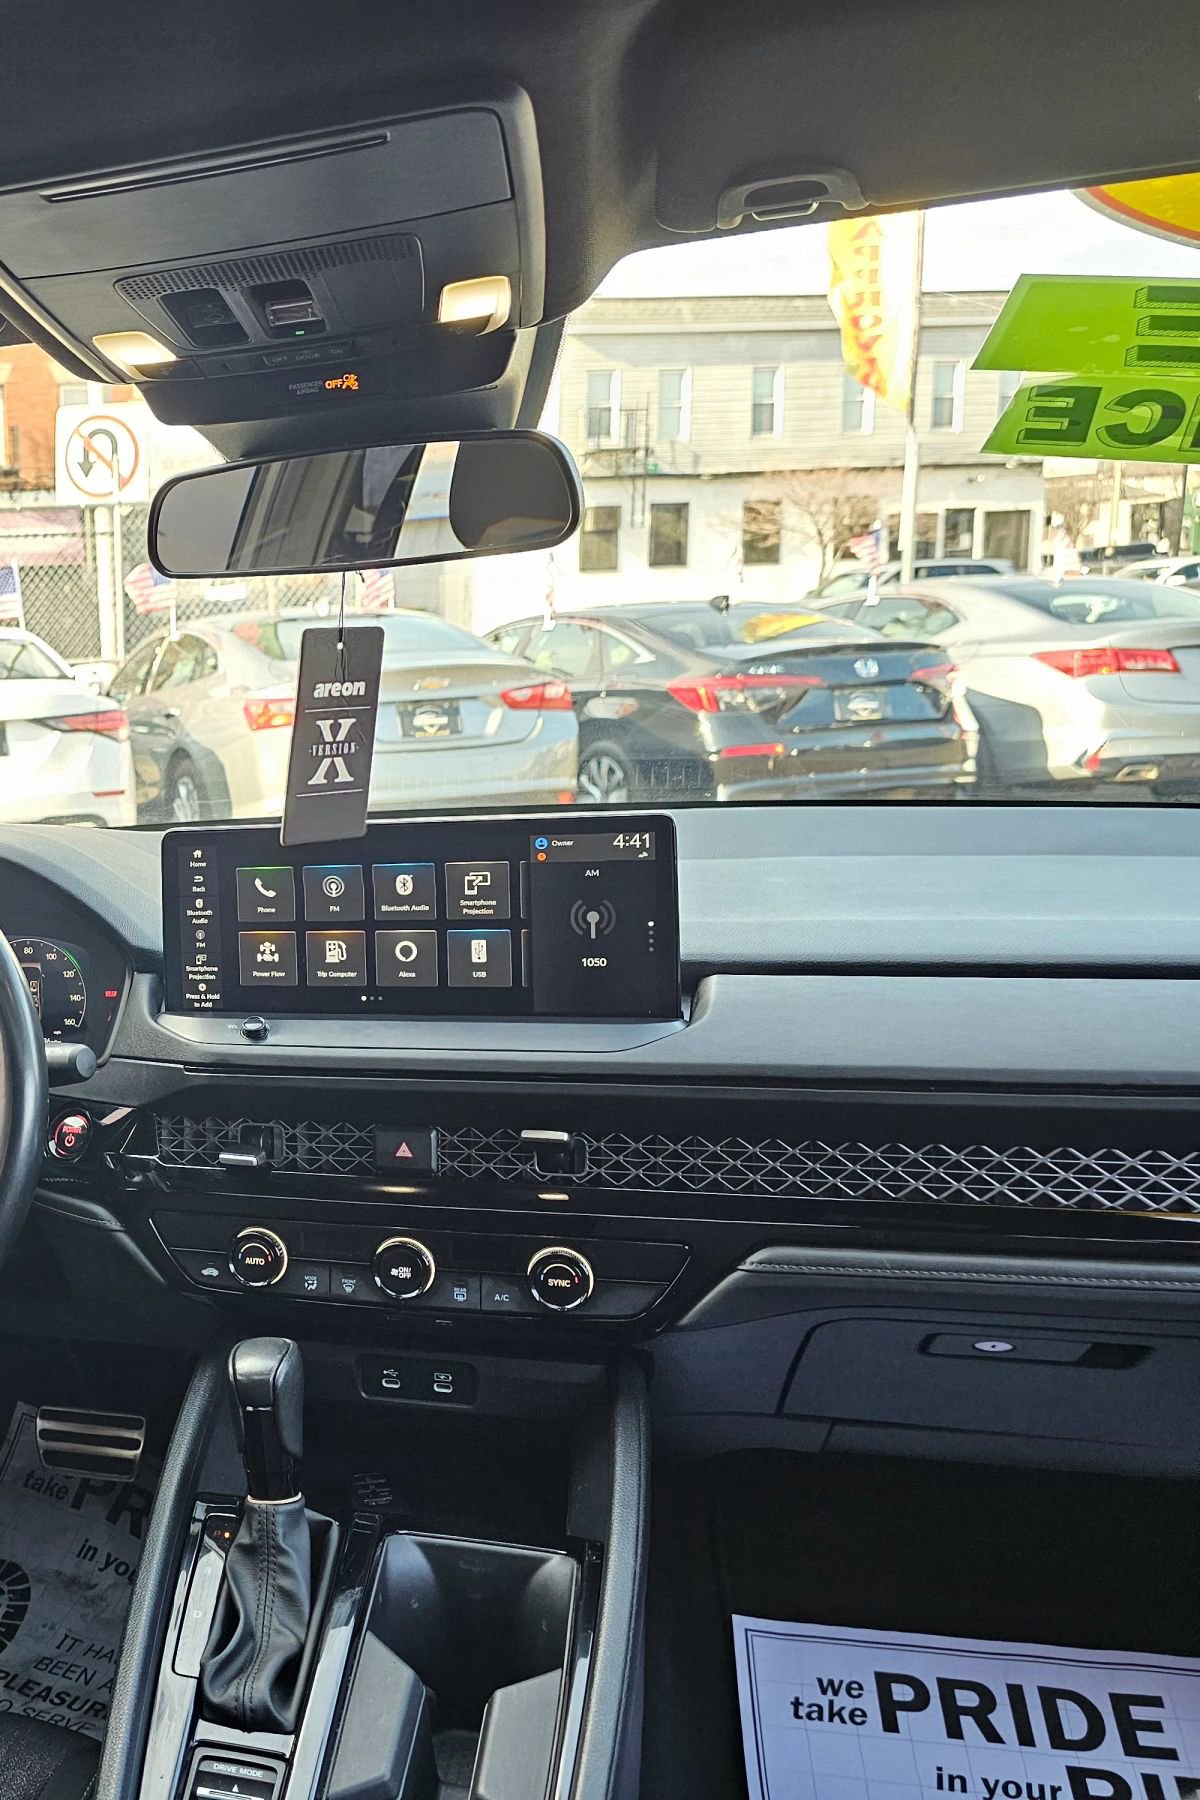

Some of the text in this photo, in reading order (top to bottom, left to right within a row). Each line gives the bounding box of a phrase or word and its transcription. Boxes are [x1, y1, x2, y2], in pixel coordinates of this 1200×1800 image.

[288, 380, 323, 391] PASSENGER
[325, 379, 343, 389] OFF
[296, 386, 319, 396] AIRBAG
[313, 681, 366, 698] areon
[312, 742, 356, 756] VERSION
[551, 833, 650, 849] Owner 4:41
[585, 869, 600, 878] AM
[460, 898, 497, 908] Smartphone
[257, 906, 276, 914] Phone
[329, 905, 340, 913] FM
[381, 904, 430, 913] Bluetooth Audio
[462, 907, 494, 916] Projection
[582, 957, 607, 967] 1050
[63, 970, 74, 978] 120
[252, 970, 286, 979] Power Flow
[317, 970, 358, 979] Trip Computer
[398, 970, 416, 978] Alexa
[63, 1018, 76, 1026] 160
[245, 1256, 265, 1266] AUTO
[398, 1272, 412, 1280] OFF
[547, 1278, 571, 1288] SYNC
[494, 1293, 510, 1302] A/C
[23, 1470, 70, 1501] take
[76, 1538, 99, 1562] in
[193, 1610, 202, 1618] D
[56, 1634, 84, 1652] IT
[33, 1656, 97, 1687] BEEN
[817, 1676, 864, 1699] we
[790, 1670, 1180, 1762] take PRIDE
[213, 1763, 264, 1778] DRIVE MODE
[936, 1766, 968, 1794] in
[981, 1776, 1063, 1800] your
